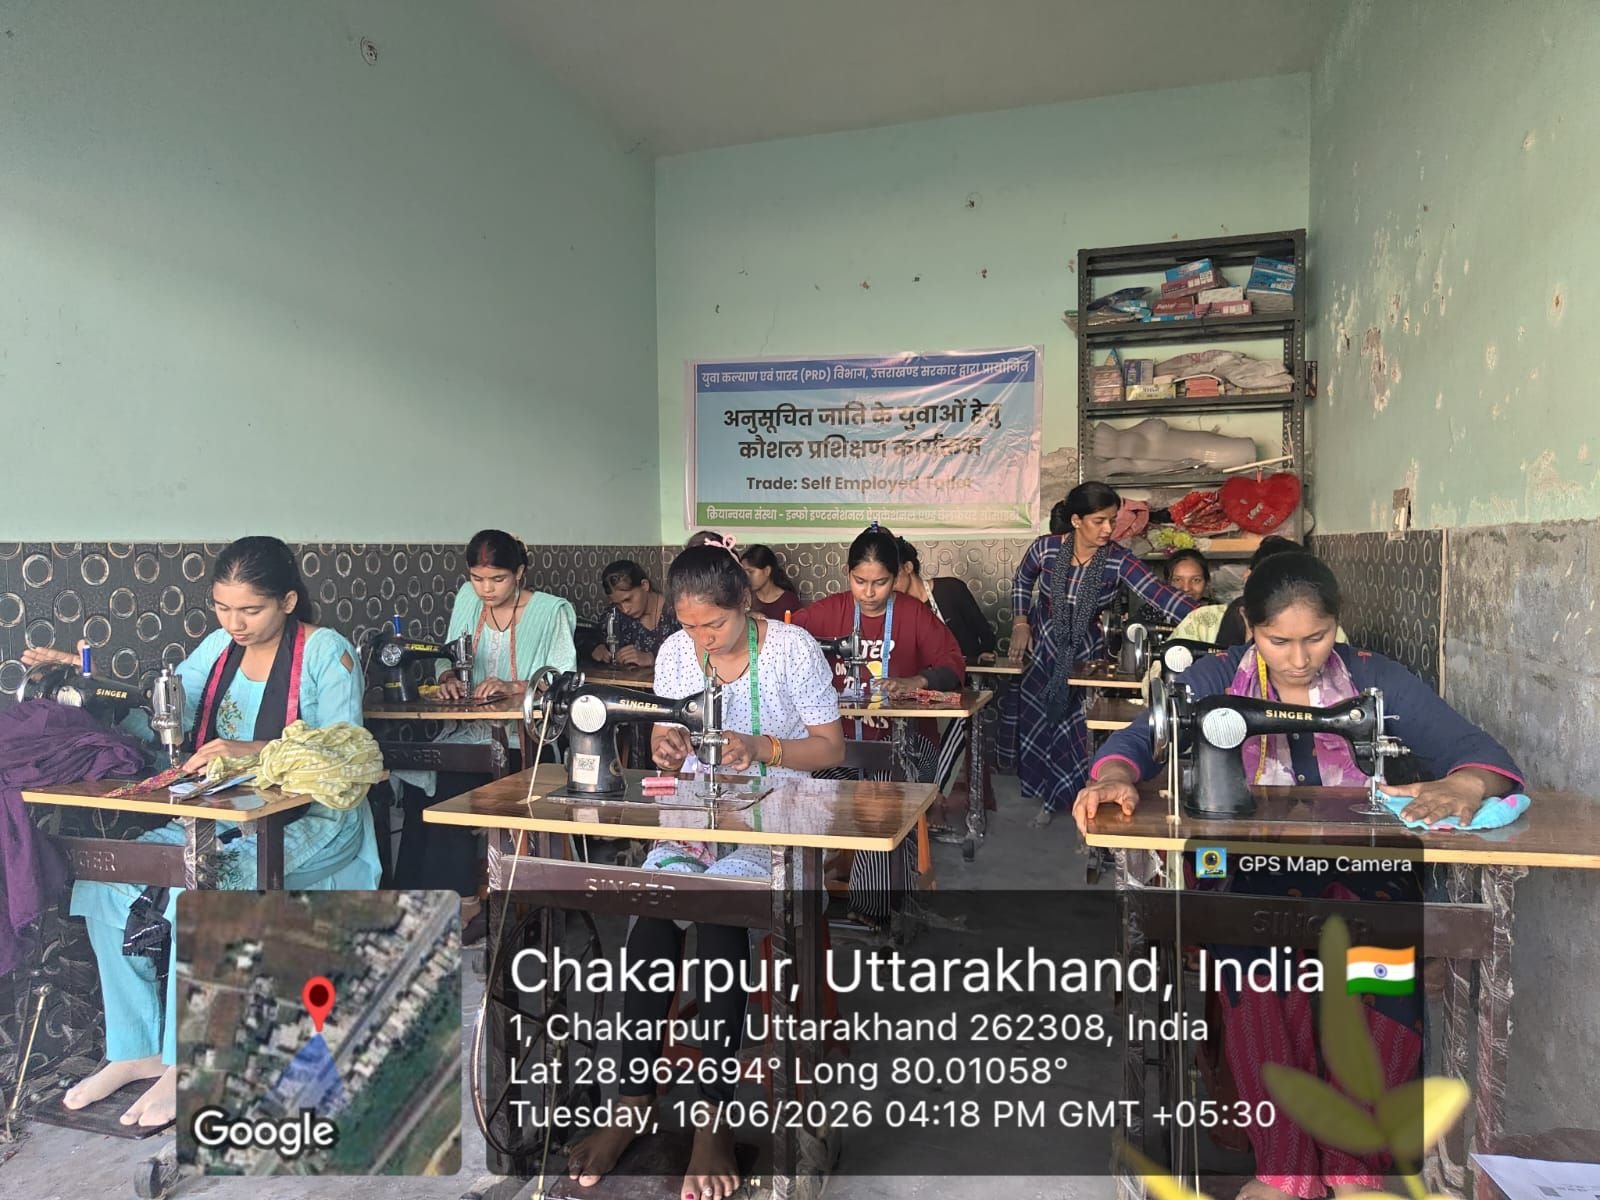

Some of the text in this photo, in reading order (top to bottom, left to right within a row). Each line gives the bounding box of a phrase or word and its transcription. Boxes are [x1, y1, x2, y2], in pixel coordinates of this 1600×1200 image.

[702, 371, 720, 388] युवा
[722, 370, 758, 385] कल्याण
[760, 367, 774, 382] एवं
[800, 366, 831, 384] (PRD)
[833, 364, 869, 381] विभाग,
[871, 365, 919, 379] उत्तराखण्ड
[920, 363, 958, 377] सरकार
[723, 403, 814, 434] अनुसूचित
[817, 401, 867, 425] जाति
[870, 401, 894, 424] के
[897, 398, 968, 431] युवाओं
[738, 435, 804, 459] कौशल
[807, 433, 888, 459] प्रशिक्षण
[746, 476, 798, 490] Trade:
[801, 476, 832, 490] Self
[835, 475, 920, 494] Employed
[706, 505, 753, 521] क्रियान्वयन
[754, 506, 778, 521] संस्था
[95, 688, 128, 699] SINGER
[619, 699, 659, 711] SINGER
[1265, 709, 1313, 721] SINGER
